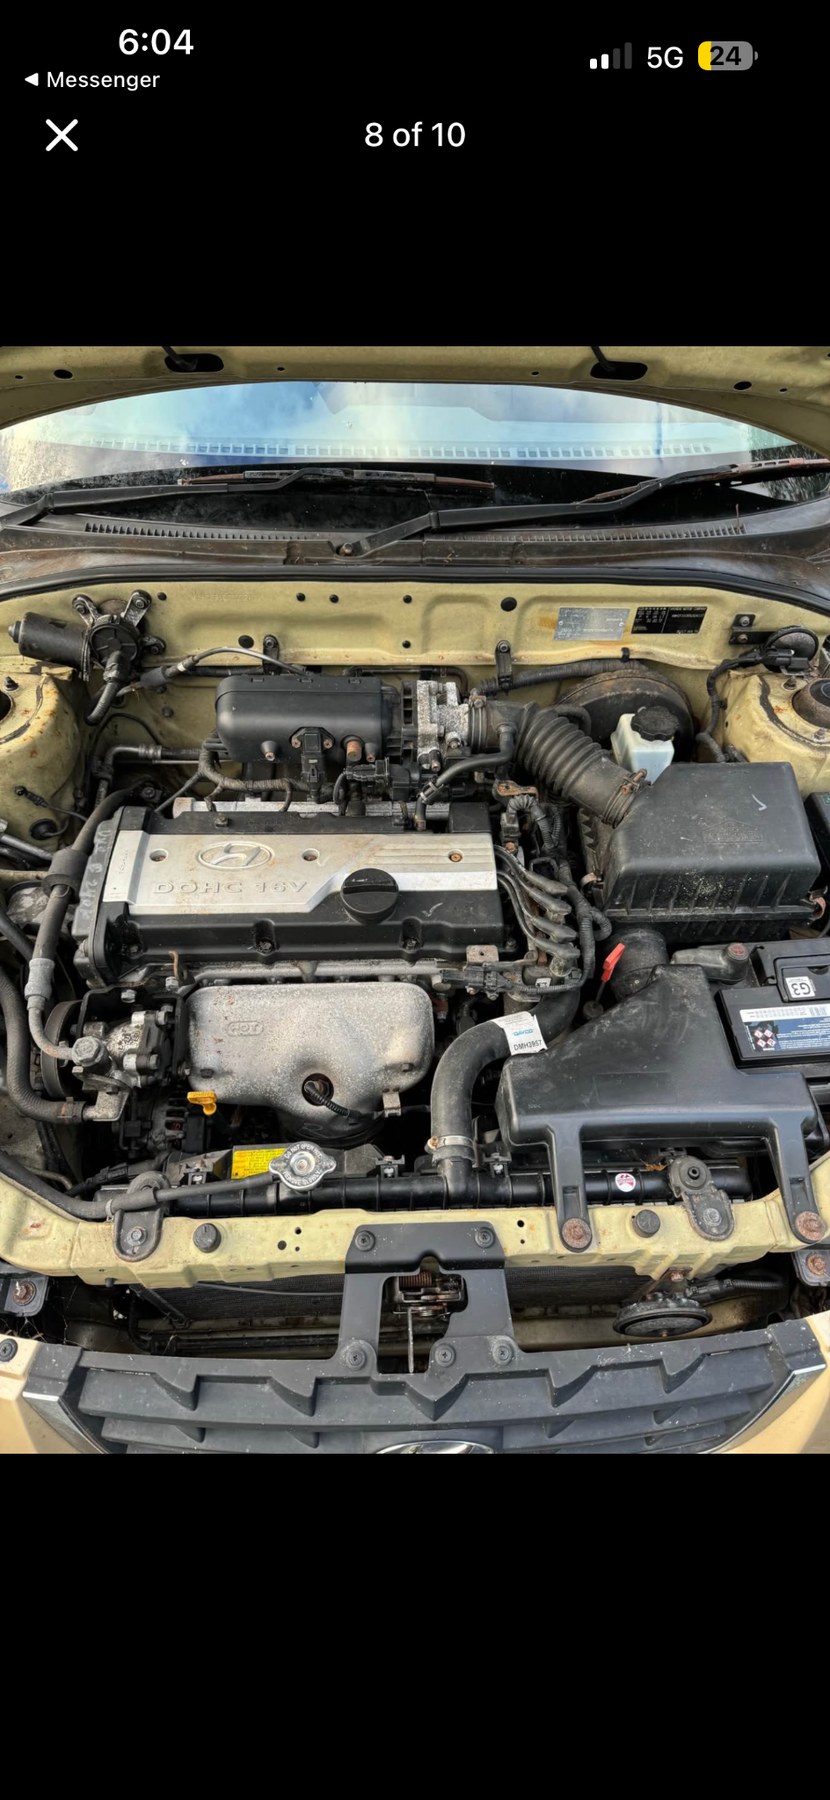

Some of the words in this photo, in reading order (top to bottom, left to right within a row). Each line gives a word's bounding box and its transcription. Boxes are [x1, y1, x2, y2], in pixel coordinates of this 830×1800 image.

[153, 880, 243, 894] DOHC
[255, 880, 308, 894] 16V
[790, 982, 811, 996] G3
[283, 1150, 292, 1160] DO
[290, 1144, 300, 1153] NOT
[301, 1143, 315, 1151] OPEN
